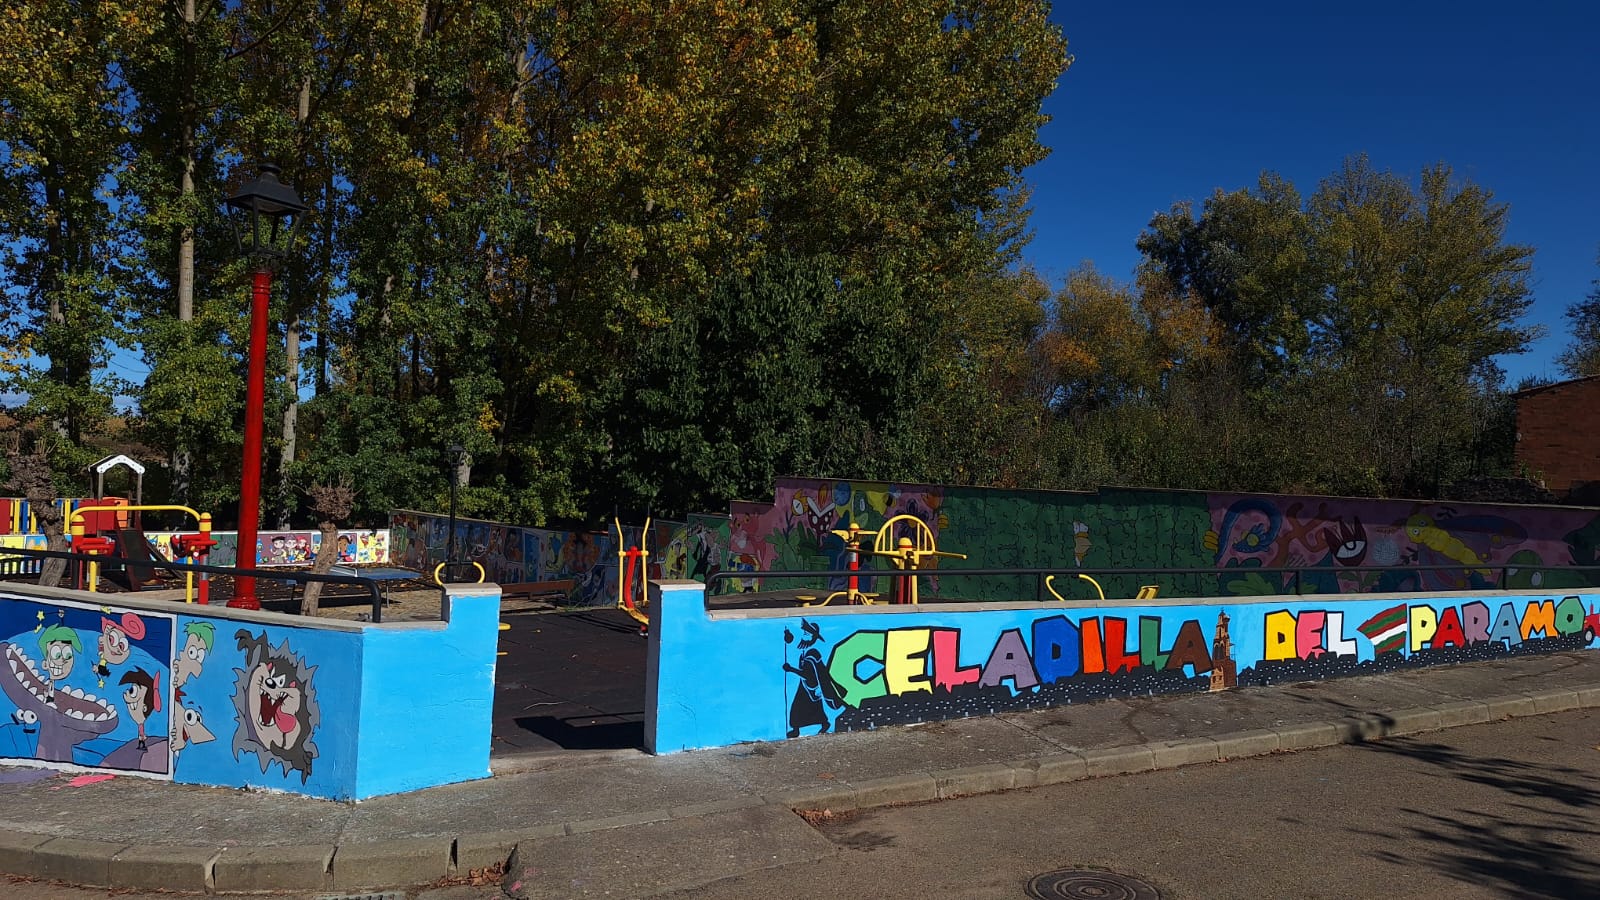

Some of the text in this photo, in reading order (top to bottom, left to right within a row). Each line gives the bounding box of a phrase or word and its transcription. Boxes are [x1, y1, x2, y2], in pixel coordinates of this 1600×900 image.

[828, 596, 1585, 708] CELADILLA DEL PARAMO
